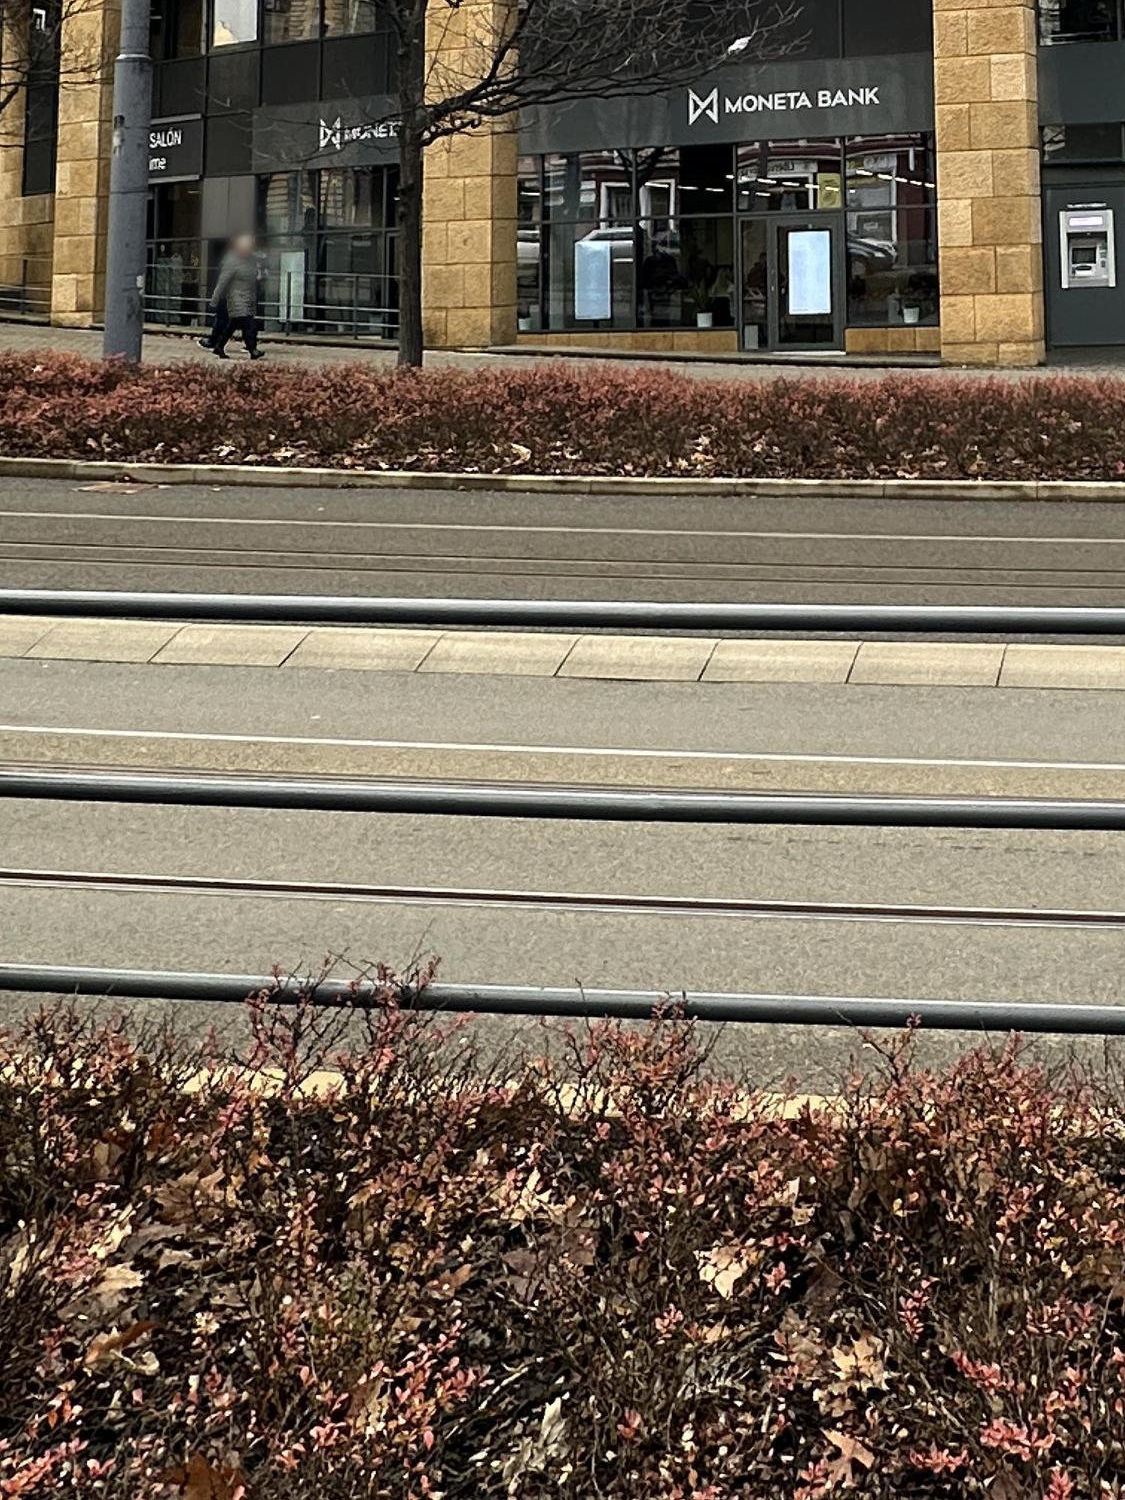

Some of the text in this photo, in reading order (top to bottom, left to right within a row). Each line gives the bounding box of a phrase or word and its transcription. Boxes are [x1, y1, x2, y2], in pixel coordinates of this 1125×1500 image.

[724, 86, 880, 114] MONETA BANK
[149, 127, 183, 149] SALÓN
[344, 121, 402, 141] MONET
